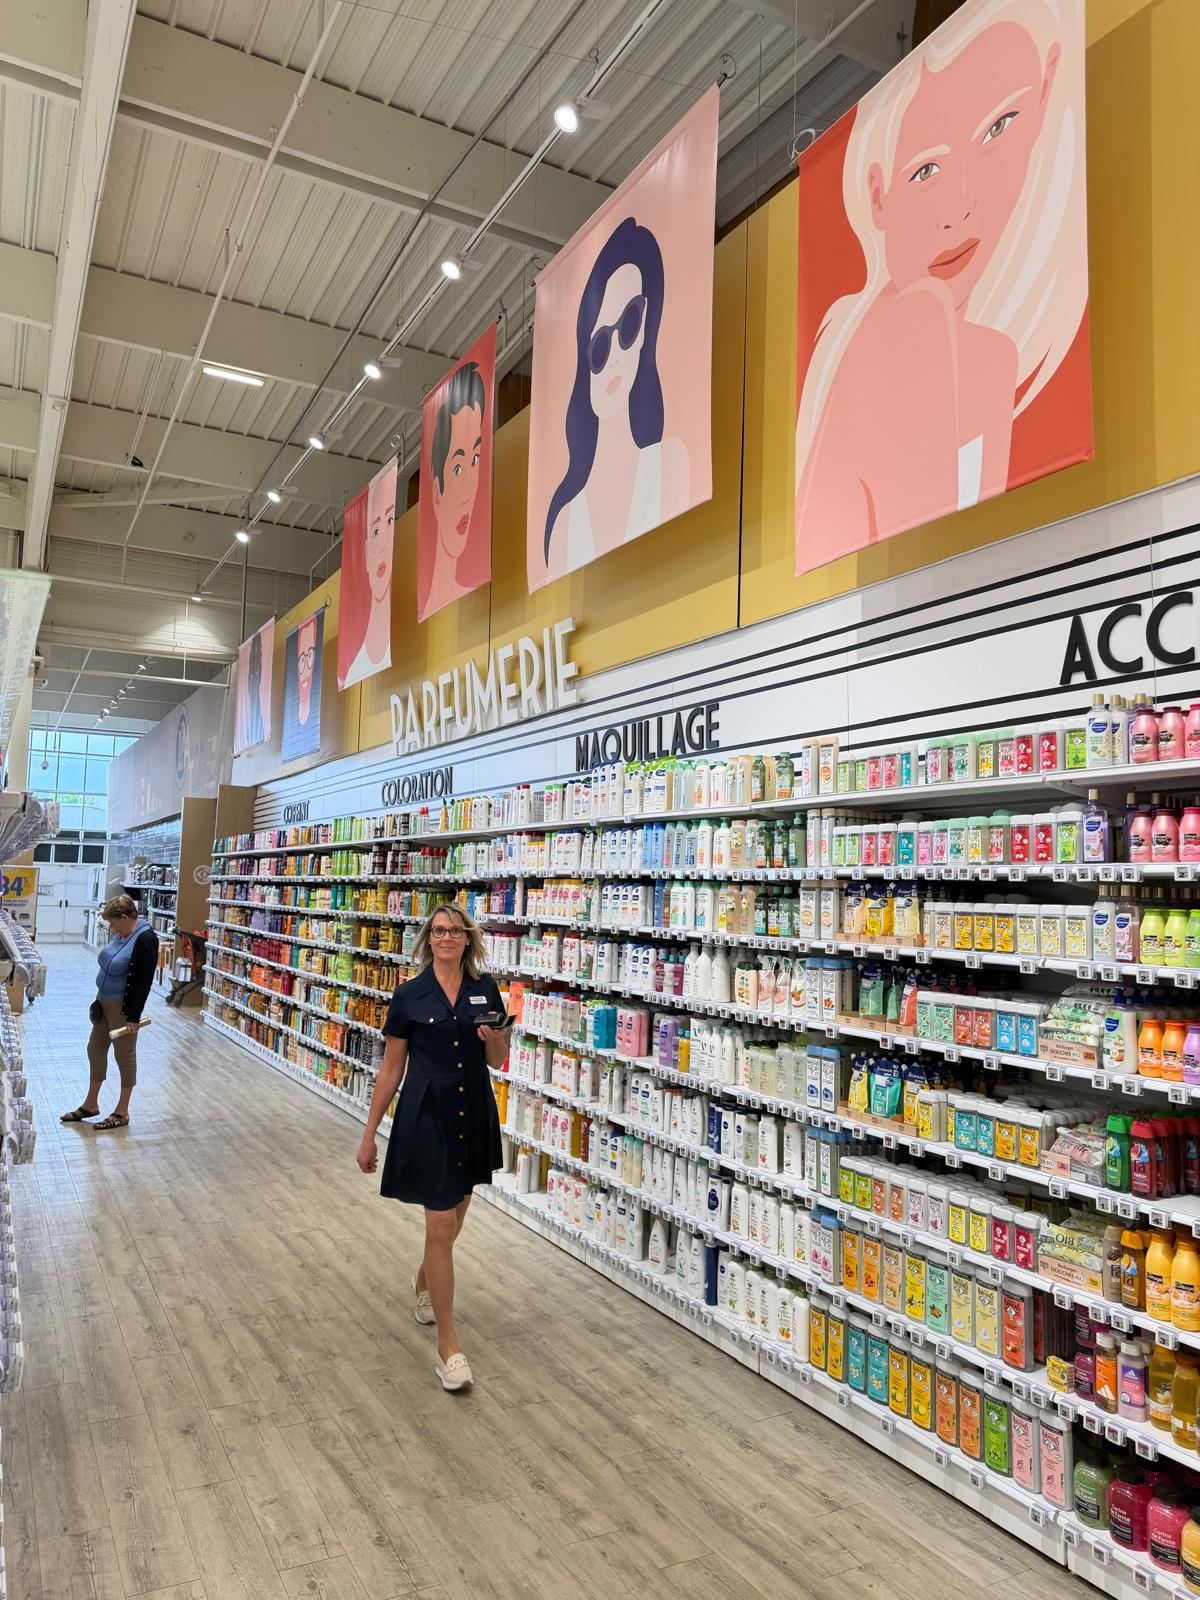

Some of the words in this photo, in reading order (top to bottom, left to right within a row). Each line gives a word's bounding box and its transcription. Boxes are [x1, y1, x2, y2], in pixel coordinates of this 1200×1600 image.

[1060, 591, 1195, 685] ACC
[390, 616, 579, 756] PARFUMERIE
[576, 703, 719, 771] MAQUILLAGE
[381, 766, 453, 807] COLORATION
